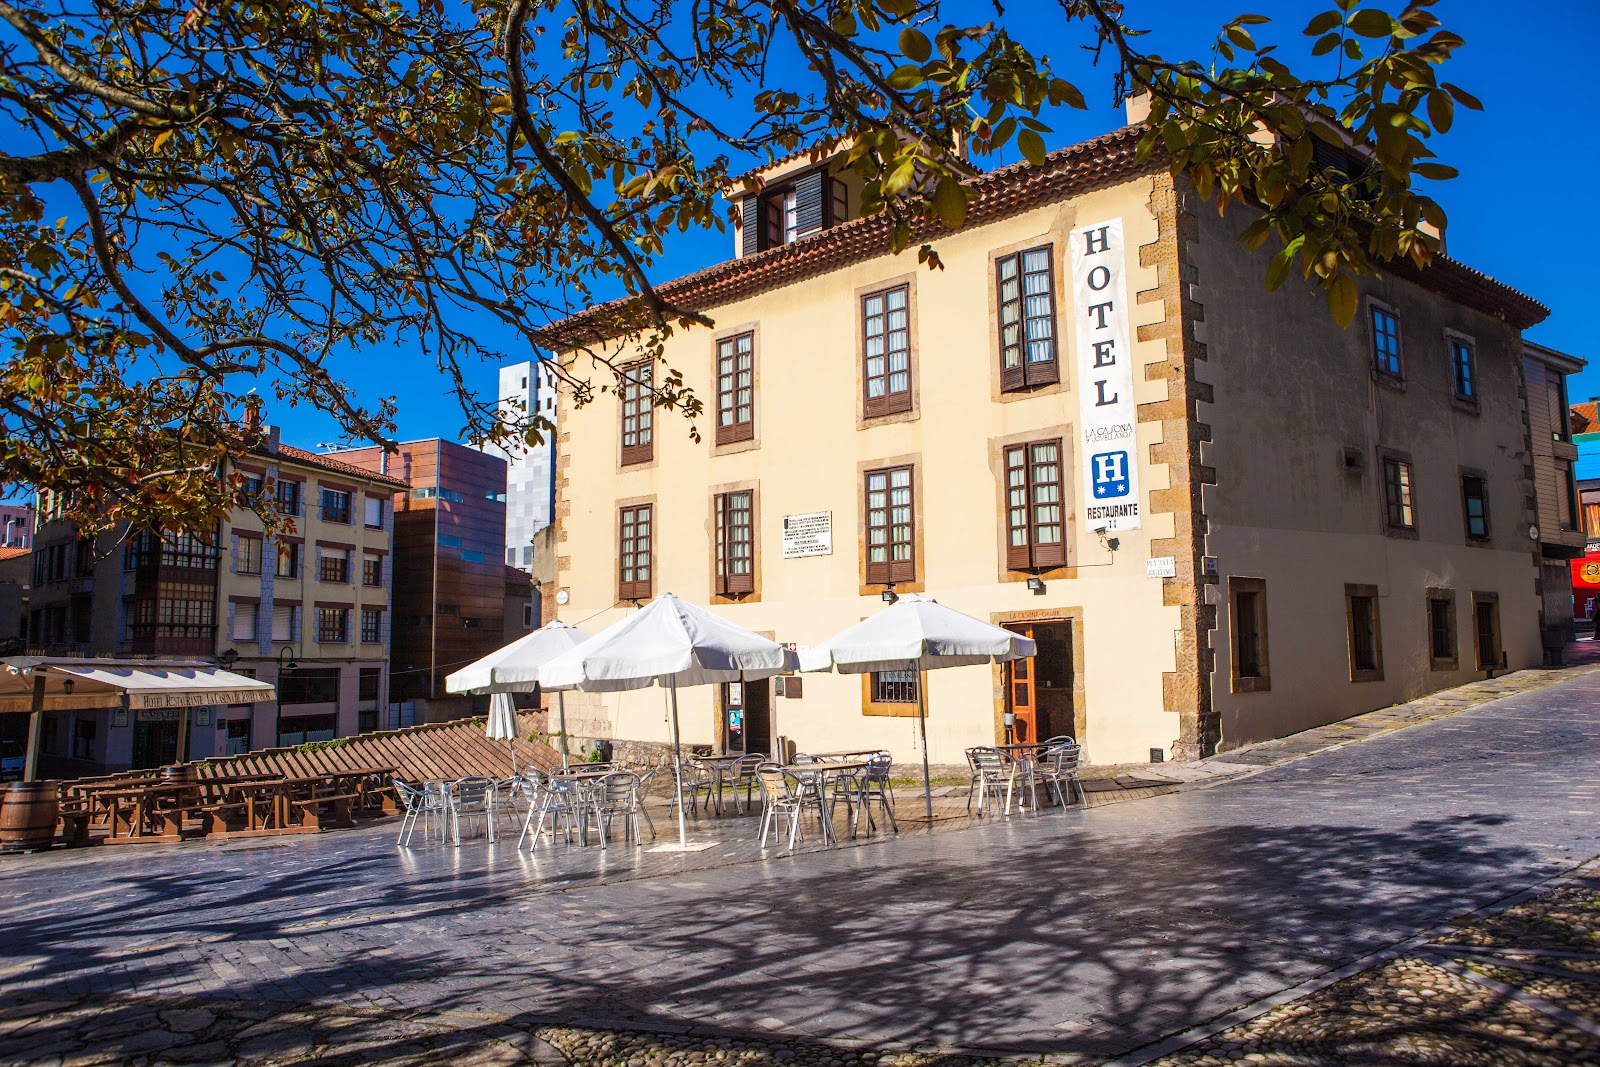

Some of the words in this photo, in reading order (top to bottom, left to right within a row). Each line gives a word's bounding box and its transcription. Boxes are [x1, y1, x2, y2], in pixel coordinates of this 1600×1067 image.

[1083, 225, 1119, 407] HOTEL
[1085, 429, 1097, 438] LA
[1097, 423, 1133, 436] CASONA
[1095, 453, 1125, 484] H
[1087, 503, 1138, 520] RESTAURANTE
[143, 695, 163, 708] HOTEL
[166, 692, 203, 707] RESTAURANTE
[206, 692, 215, 705] LA
